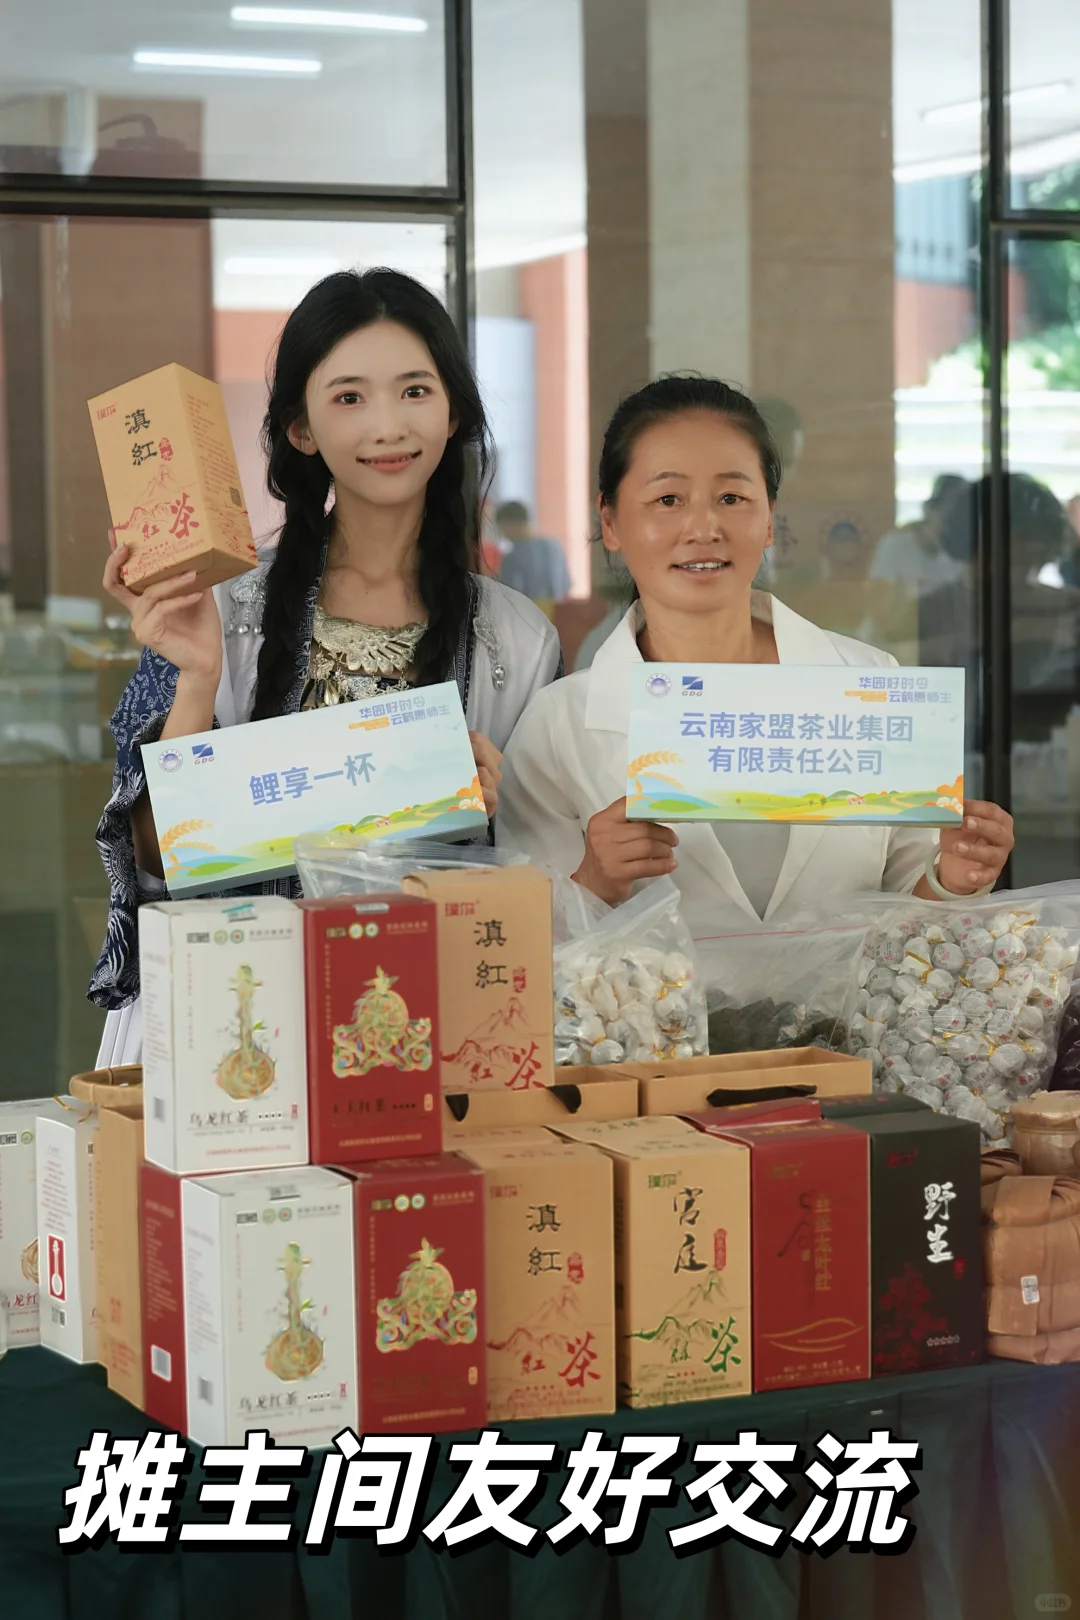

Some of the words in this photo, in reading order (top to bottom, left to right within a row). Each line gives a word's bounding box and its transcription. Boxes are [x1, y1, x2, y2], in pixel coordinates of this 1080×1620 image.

[679, 711, 914, 743] 云南家盟茶业集团
[194, 754, 215, 766] GDG
[707, 745, 883, 776] 有限责任公司
[249, 751, 377, 806] 鲤享一杯
[923, 1181, 957, 1264] 野生
[6, 1291, 38, 1309] 龙红
